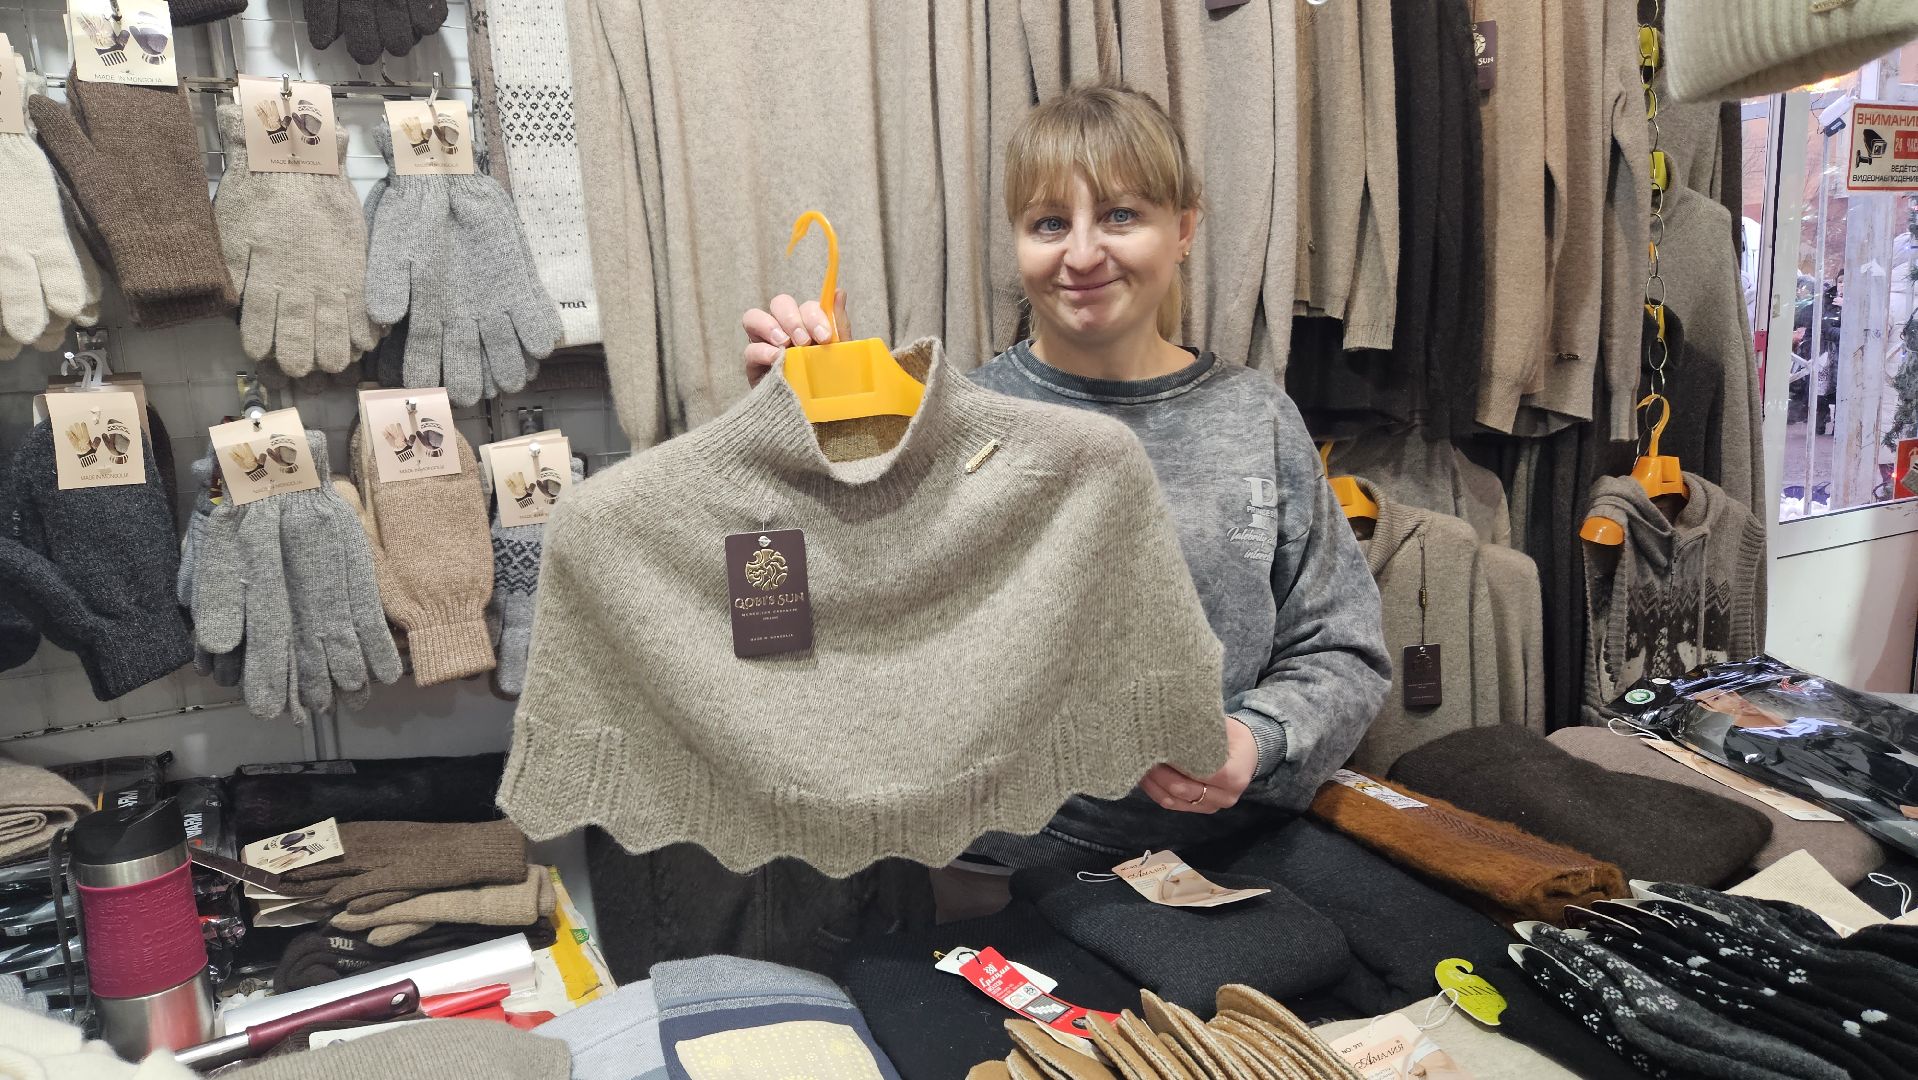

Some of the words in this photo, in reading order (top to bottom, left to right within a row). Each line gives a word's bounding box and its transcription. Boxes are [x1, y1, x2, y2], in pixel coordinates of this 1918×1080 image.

[1478, 57, 1494, 66] SUN
[1891, 164, 1918, 174] ВЕДЁТС
[777, 591, 805, 606] SUN
